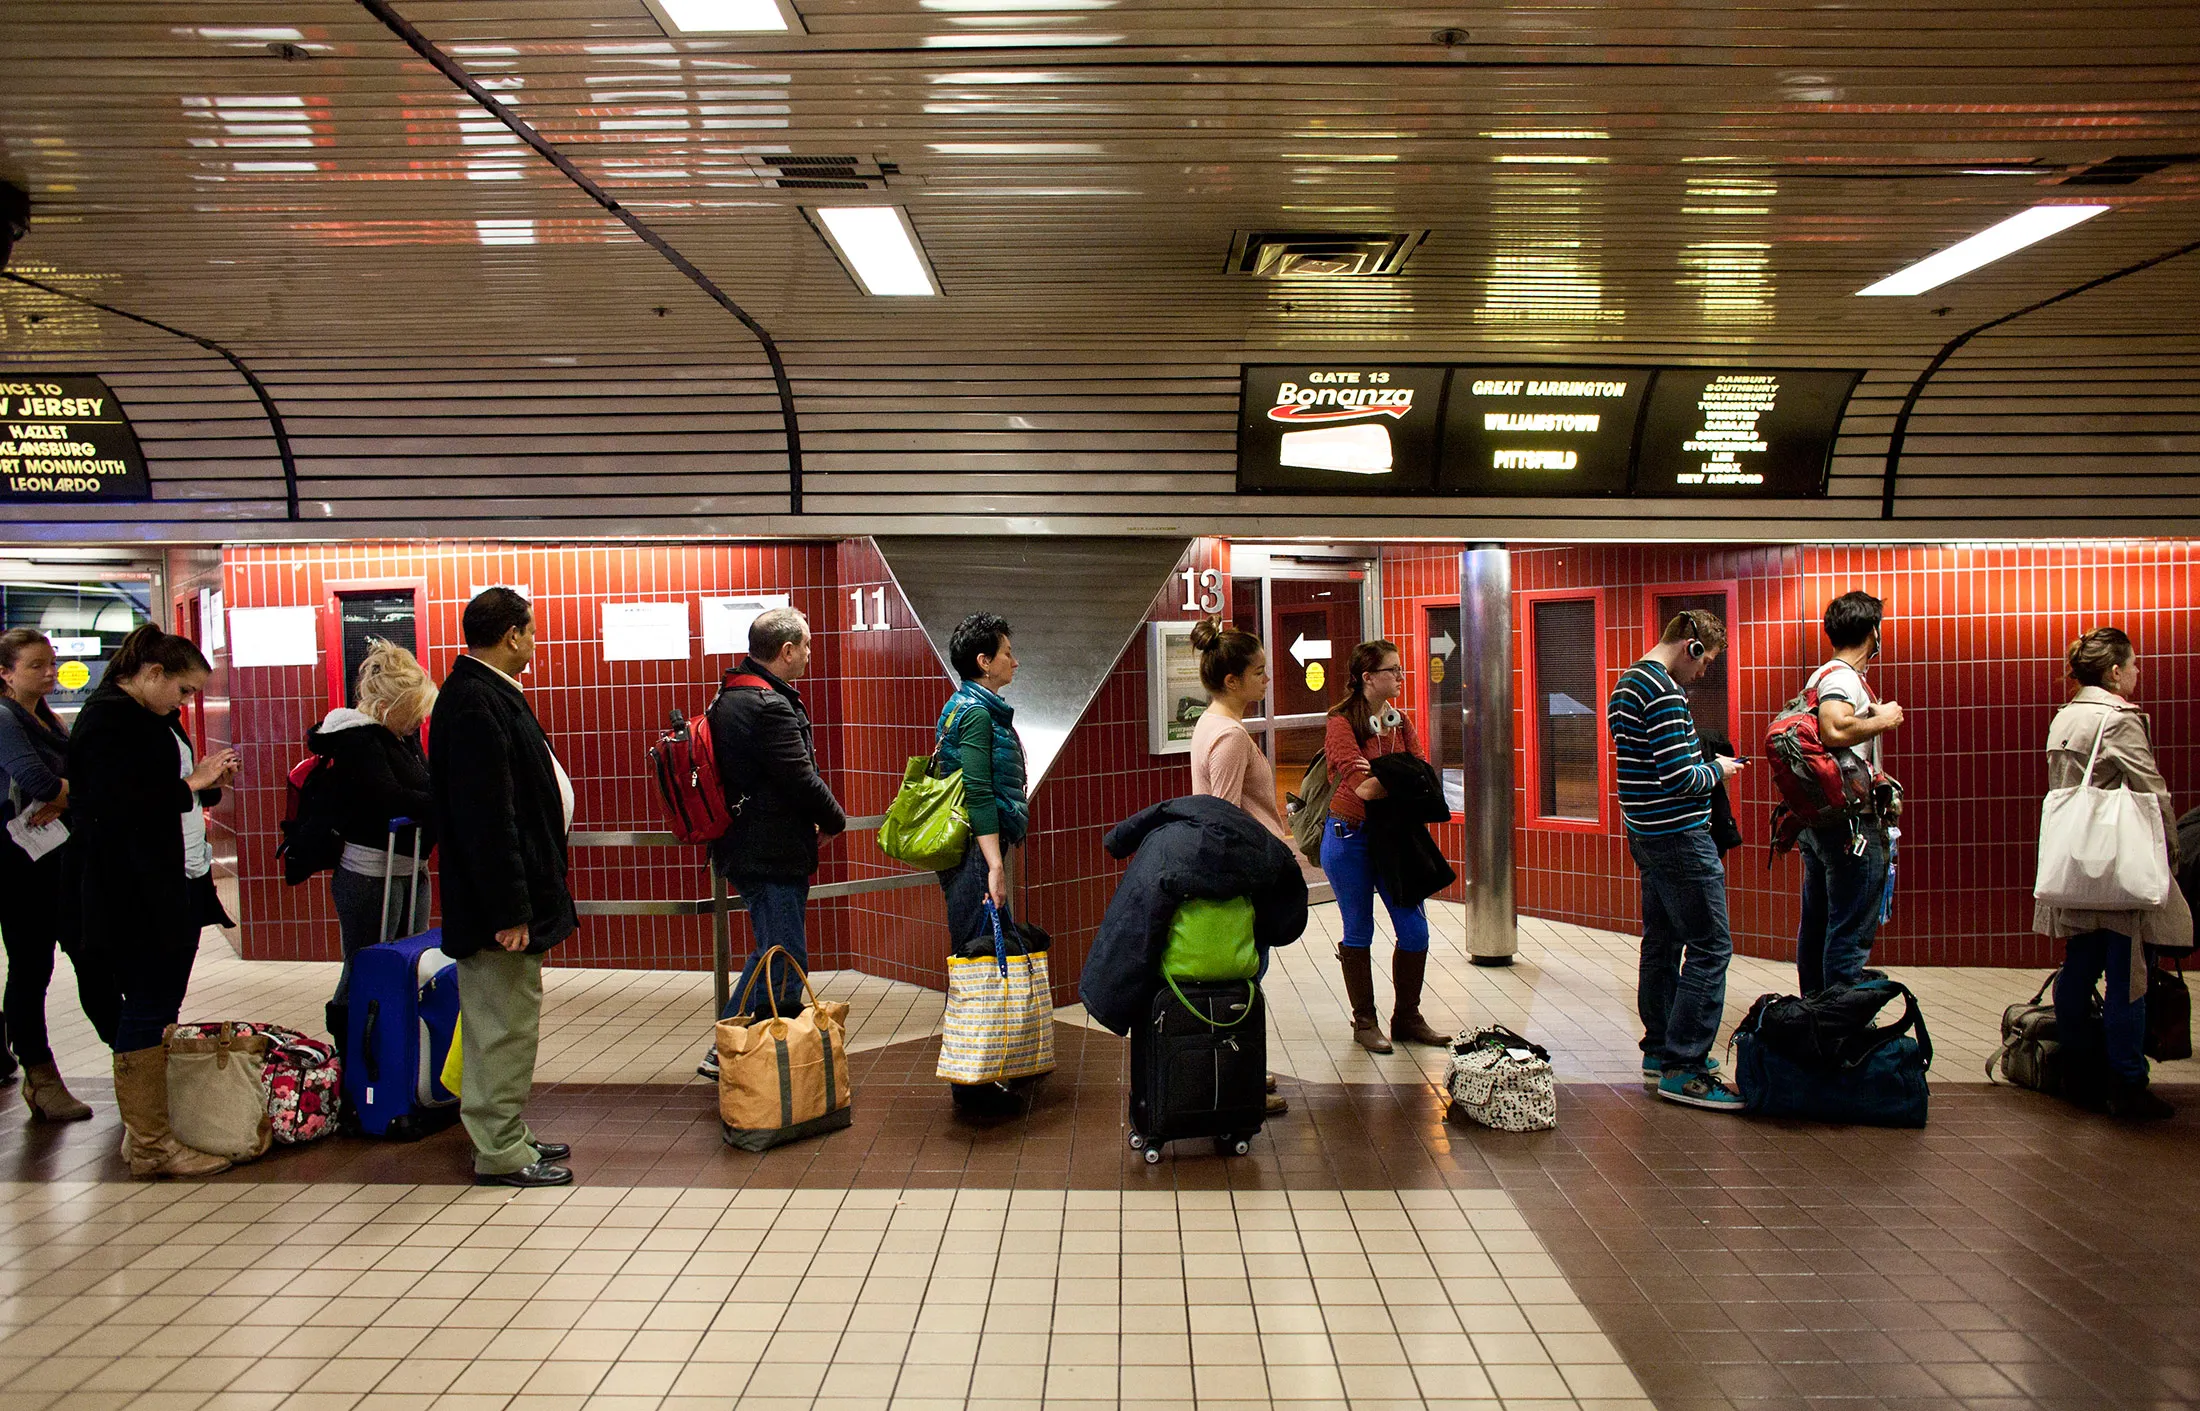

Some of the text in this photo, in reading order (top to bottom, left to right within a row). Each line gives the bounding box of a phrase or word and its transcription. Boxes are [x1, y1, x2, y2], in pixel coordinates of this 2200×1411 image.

[1309, 371, 1391, 384] GATE 13
[1716, 375, 1775, 384] DANBURY
[36, 383, 63, 396] TO
[1275, 382, 1415, 406] Bonanza
[1471, 380, 1628, 397] GREAT BARRINGTON
[1705, 384, 1779, 392] SOUTHBURY
[1702, 392, 1776, 401] WATERBURY
[18, 397, 104, 416] JERSEY
[1484, 413, 1601, 432] WILLIAMSTOWN
[8, 424, 69, 440] HAZLET
[0, 441, 97, 457] KEANSBURG
[0, 459, 127, 475] RT MONMOUTH
[1493, 450, 1578, 470] PITTSFIELD
[9, 477, 101, 493] LEONARDO
[1181, 566, 1225, 613] 13
[850, 586, 891, 631] 11
